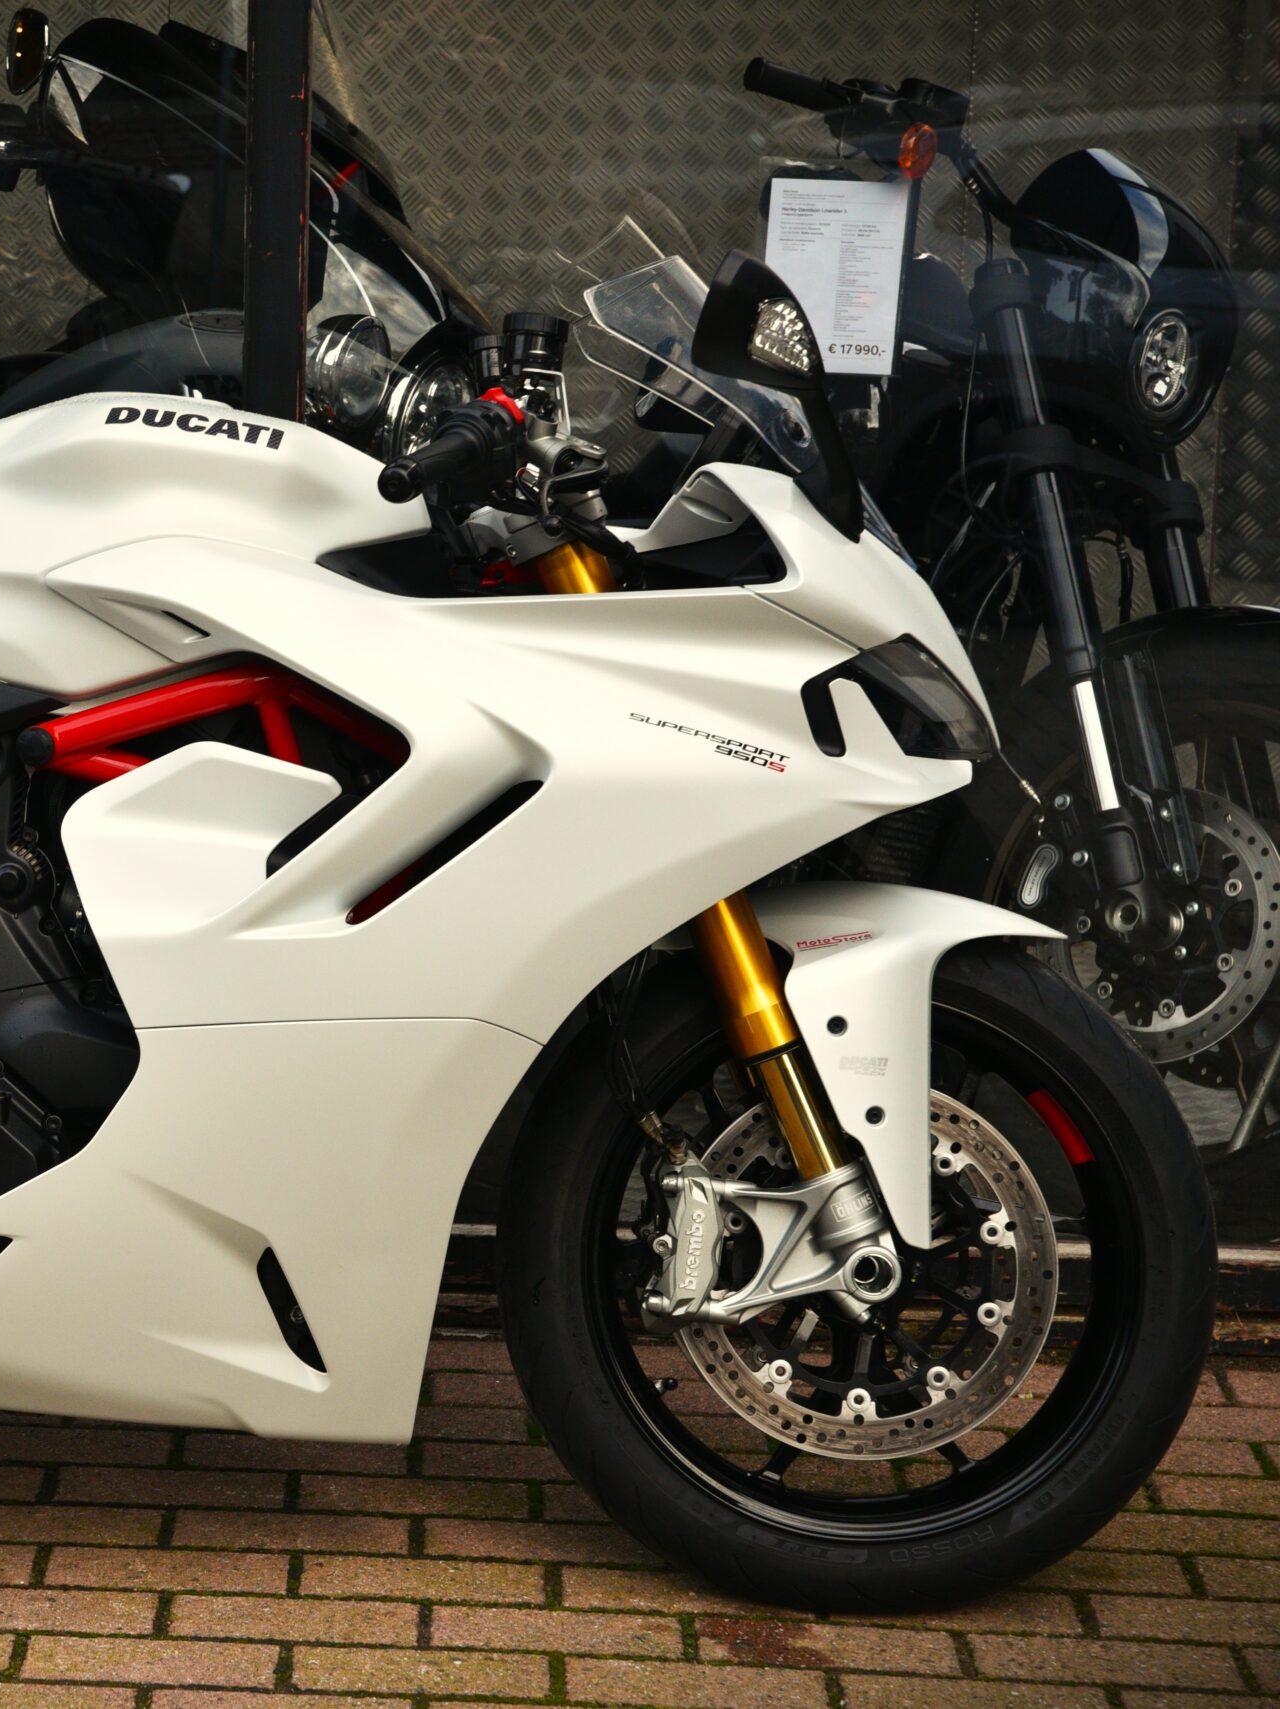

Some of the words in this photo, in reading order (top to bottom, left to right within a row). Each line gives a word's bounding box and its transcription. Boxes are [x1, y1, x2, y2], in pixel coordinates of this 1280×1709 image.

[829, 343, 837, 354] €
[105, 406, 285, 450] DUCATI
[628, 712, 791, 762] SUPERSPORT
[714, 744, 787, 773] 950S
[796, 930, 873, 949] MotoStore
[839, 1055, 889, 1068] DUCATI
[835, 1193, 873, 1218] ÖHLINS
[679, 1209, 705, 1291] brembo
[888, 1521, 996, 1565] ROSSO
